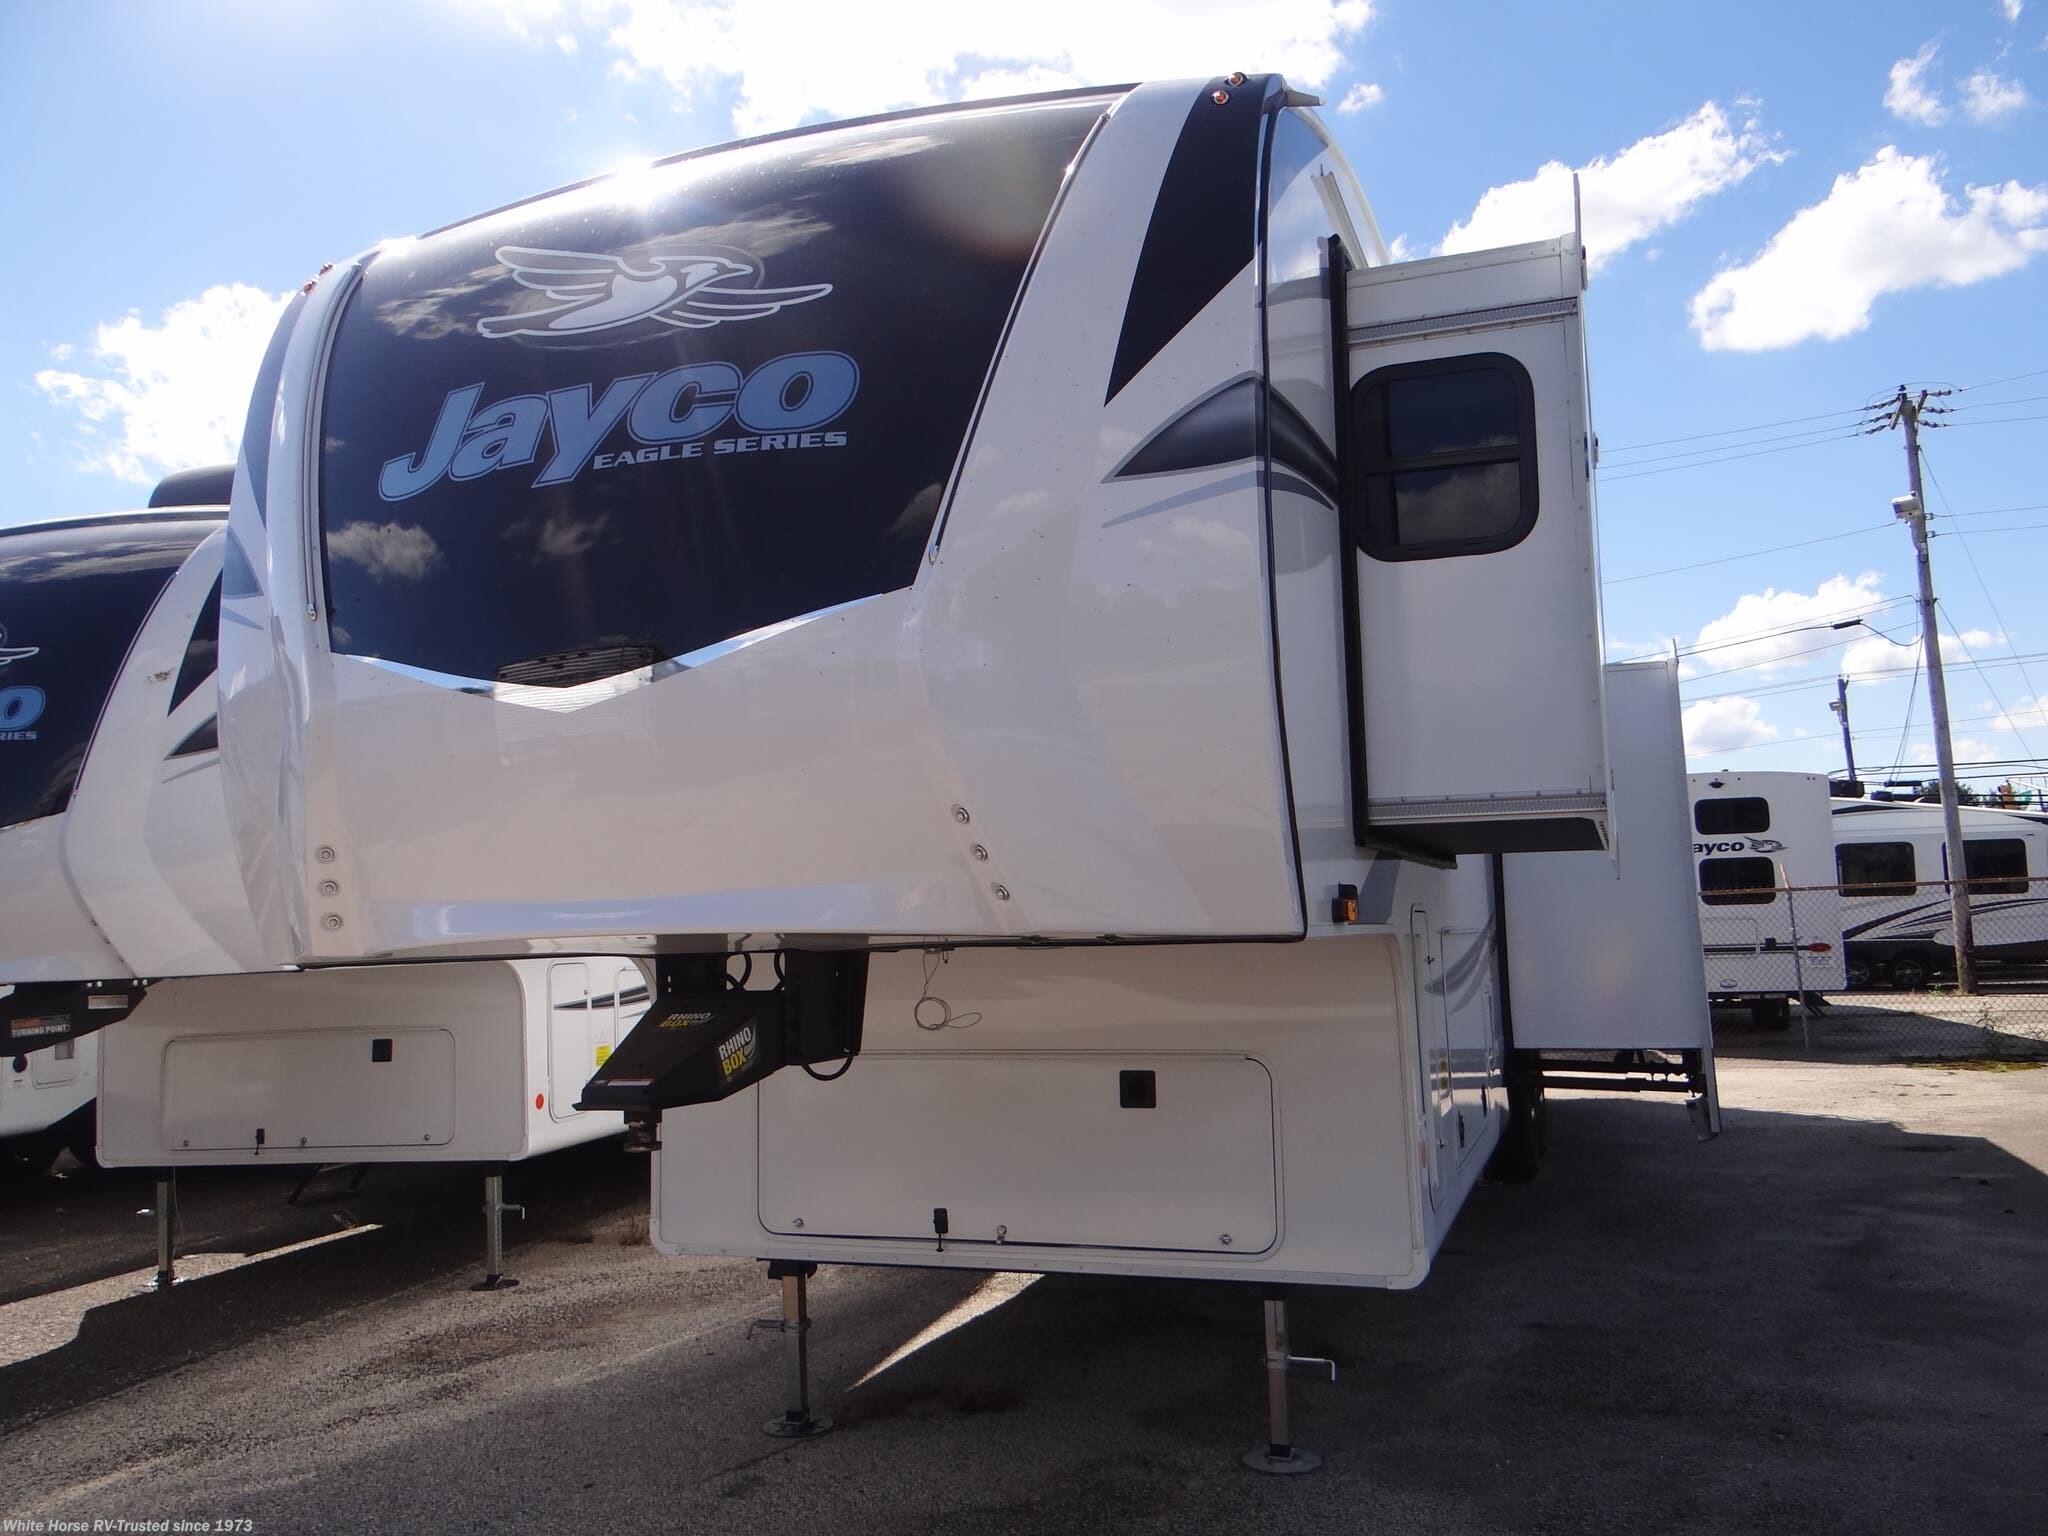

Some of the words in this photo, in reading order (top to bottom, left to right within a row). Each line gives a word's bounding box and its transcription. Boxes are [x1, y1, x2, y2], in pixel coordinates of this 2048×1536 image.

[378, 350, 860, 501] Jayco
[593, 441, 704, 469] EAGLE
[713, 431, 848, 455] SERIES
[0, 731, 38, 740] RIES
[1693, 842, 1745, 856] ayco
[667, 1012, 712, 1020] RHINO
[660, 1019, 690, 1028] BOX
[11, 1026, 44, 1038] TURNING
[45, 1024, 67, 1034] POINT
[719, 1027, 752, 1061] RHINO
[722, 1048, 747, 1076] BOX
